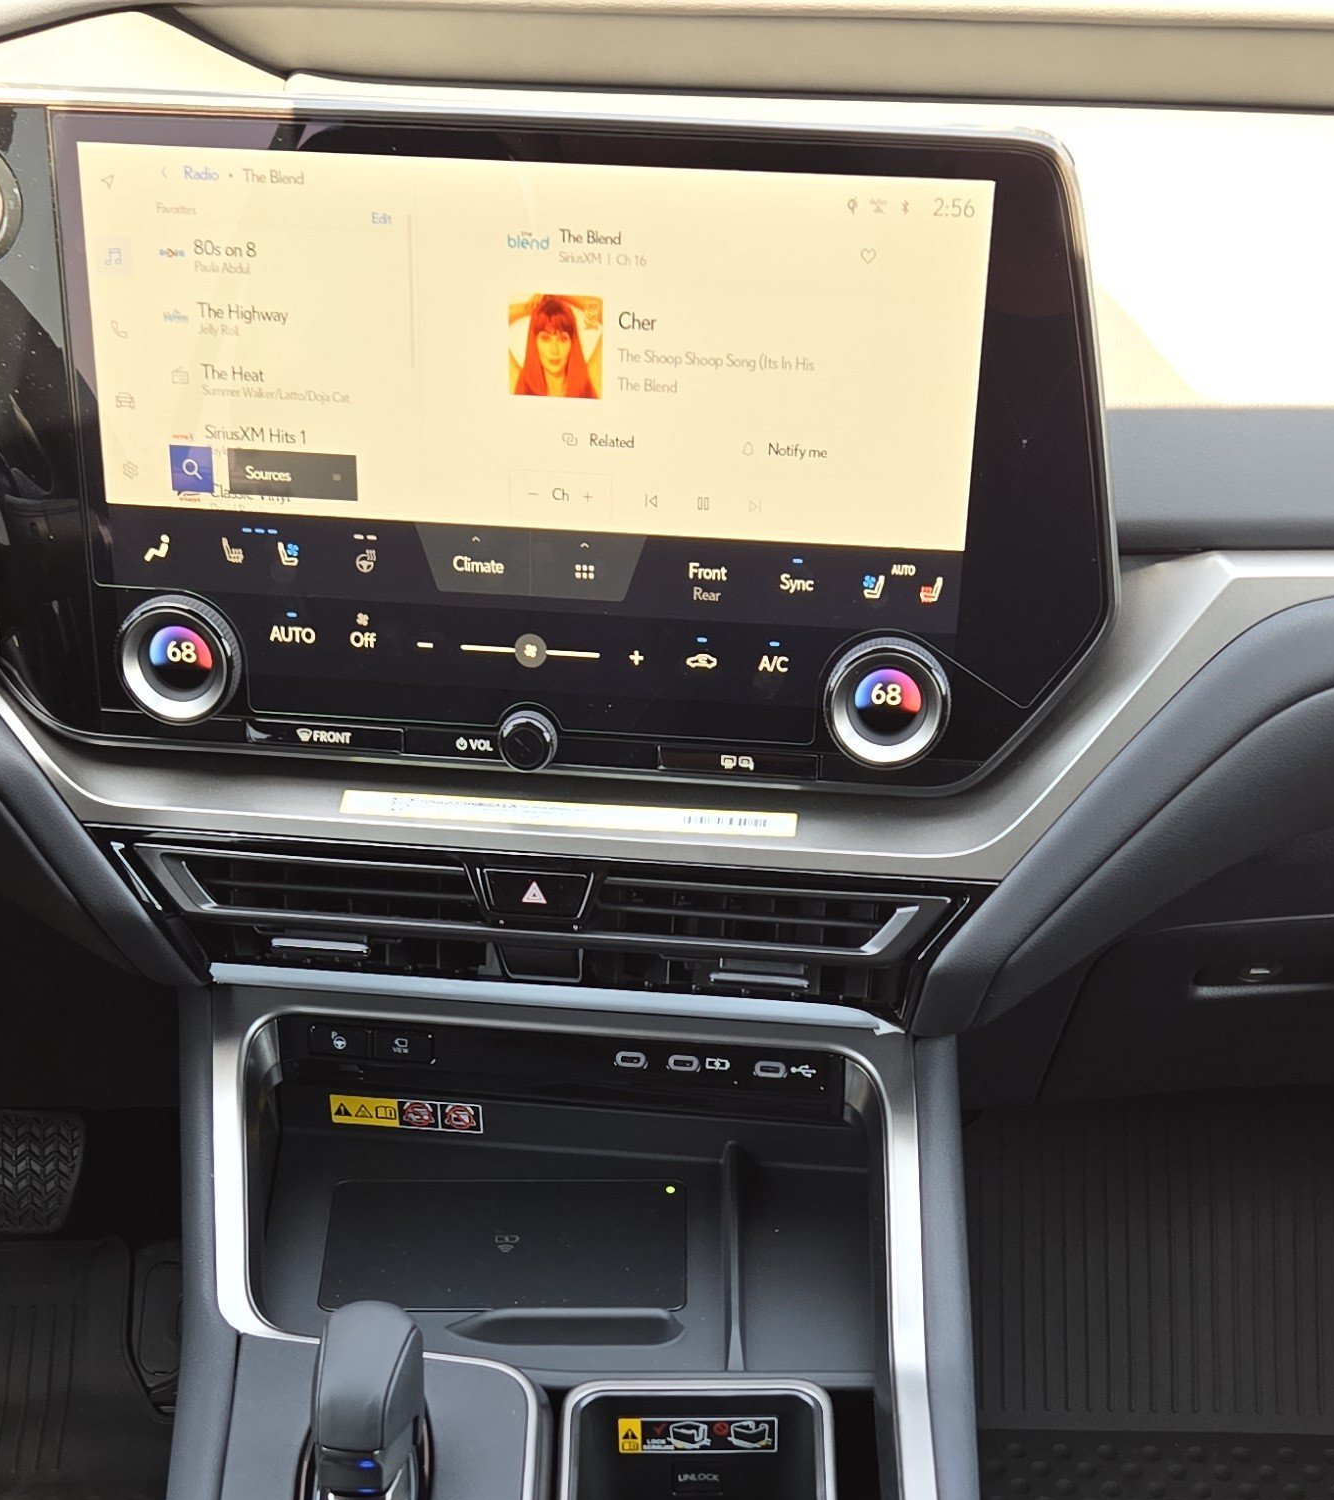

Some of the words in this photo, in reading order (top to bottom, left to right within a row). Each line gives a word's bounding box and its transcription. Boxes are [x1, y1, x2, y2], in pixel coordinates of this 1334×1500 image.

[184, 166, 219, 181] Radio
[243, 168, 266, 183] The
[270, 170, 305, 185] Blend
[156, 202, 197, 215] Favorites
[933, 197, 975, 218] 2:56
[372, 212, 392, 225] Edit
[507, 234, 550, 250] blend
[559, 228, 583, 244] The
[587, 230, 622, 245] Blend
[194, 239, 221, 256] 80s
[225, 245, 243, 257] on
[246, 241, 257, 258] 8
[194, 261, 219, 273] Paula
[222, 262, 250, 275] Abdul
[559, 251, 602, 265] SiriusXM
[617, 254, 631, 266] Ch
[634, 254, 648, 267] 16
[196, 301, 224, 319] The
[228, 303, 288, 325] Highway
[618, 311, 657, 331] Cher
[198, 324, 218, 337] Jelly
[221, 325, 240, 336] Roll
[617, 348, 641, 363] The
[644, 349, 683, 368] Shoop
[685, 351, 723, 370] Shoop
[726, 353, 756, 372] Song
[781, 355, 793, 370] In
[796, 356, 815, 372] His
[200, 363, 227, 380] The
[232, 366, 265, 382] Heat
[202, 385, 240, 397] Summer
[333, 391, 351, 404] Cat
[617, 377, 640, 392] The
[644, 379, 678, 394] Blend
[205, 425, 265, 443] SiriusXM
[270, 429, 297, 444] Hits
[300, 430, 307, 445] 1
[590, 433, 635, 449] Related
[768, 442, 806, 460] Notify
[809, 448, 828, 459] me
[245, 465, 292, 482] Sources
[552, 488, 570, 502] Ch
[452, 556, 505, 575] Climate
[688, 562, 727, 581] Front
[891, 564, 917, 577] AUTO
[779, 574, 814, 594] Sync
[693, 586, 721, 602] Rear
[269, 626, 316, 645] AUTO
[350, 631, 376, 648] Off
[167, 641, 197, 663] 68
[758, 655, 789, 673] A/C
[871, 683, 902, 706] 68
[313, 729, 352, 745] FRONT
[469, 738, 493, 752] VOL
[677, 1472, 720, 1482] UNLOCK
